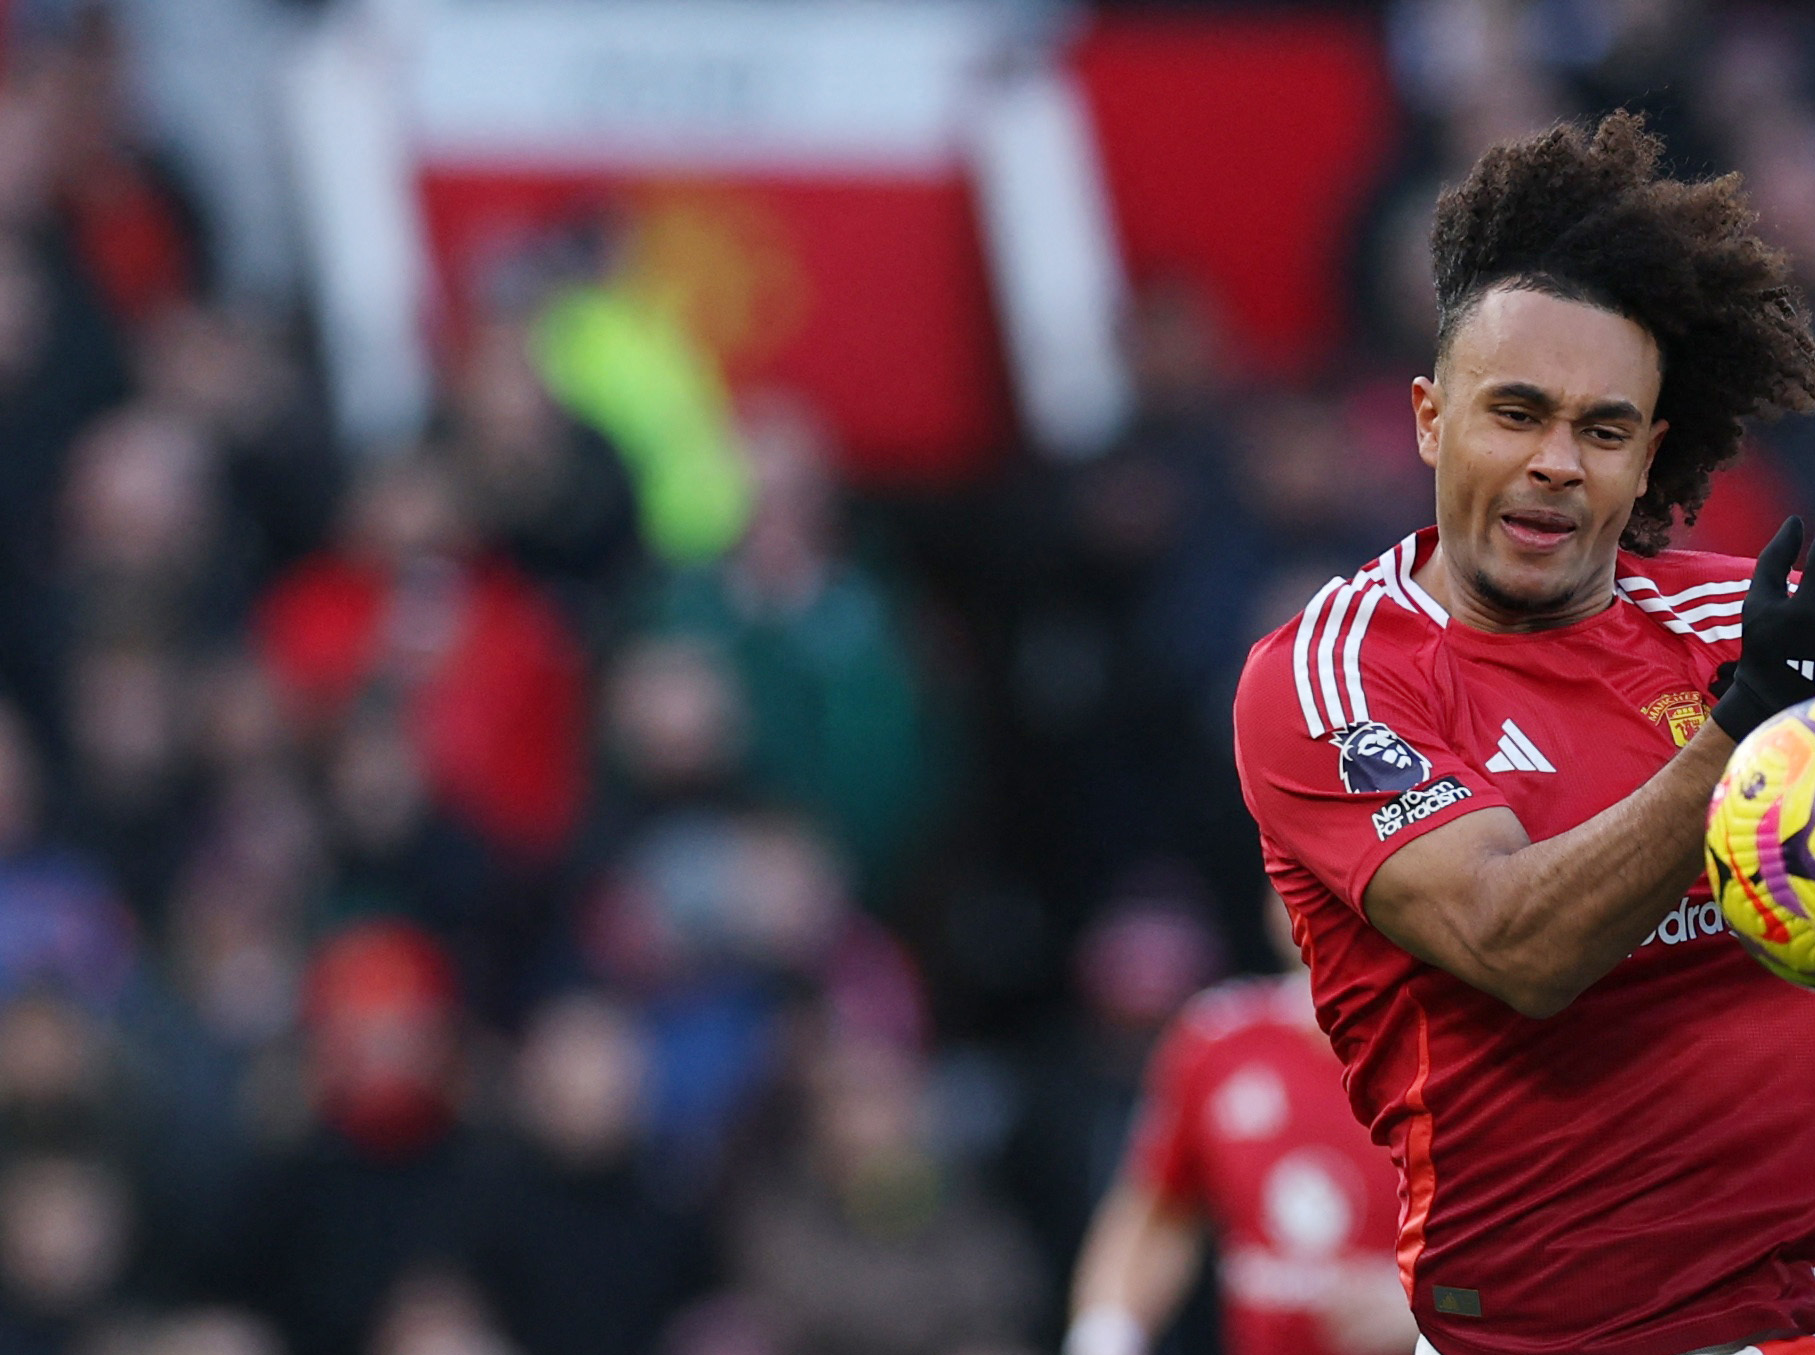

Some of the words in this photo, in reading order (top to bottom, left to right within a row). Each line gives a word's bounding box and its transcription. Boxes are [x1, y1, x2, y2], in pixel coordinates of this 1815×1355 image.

[1372, 804, 1401, 828] No
[1377, 815, 1404, 841] for
[1406, 787, 1472, 823] racism
